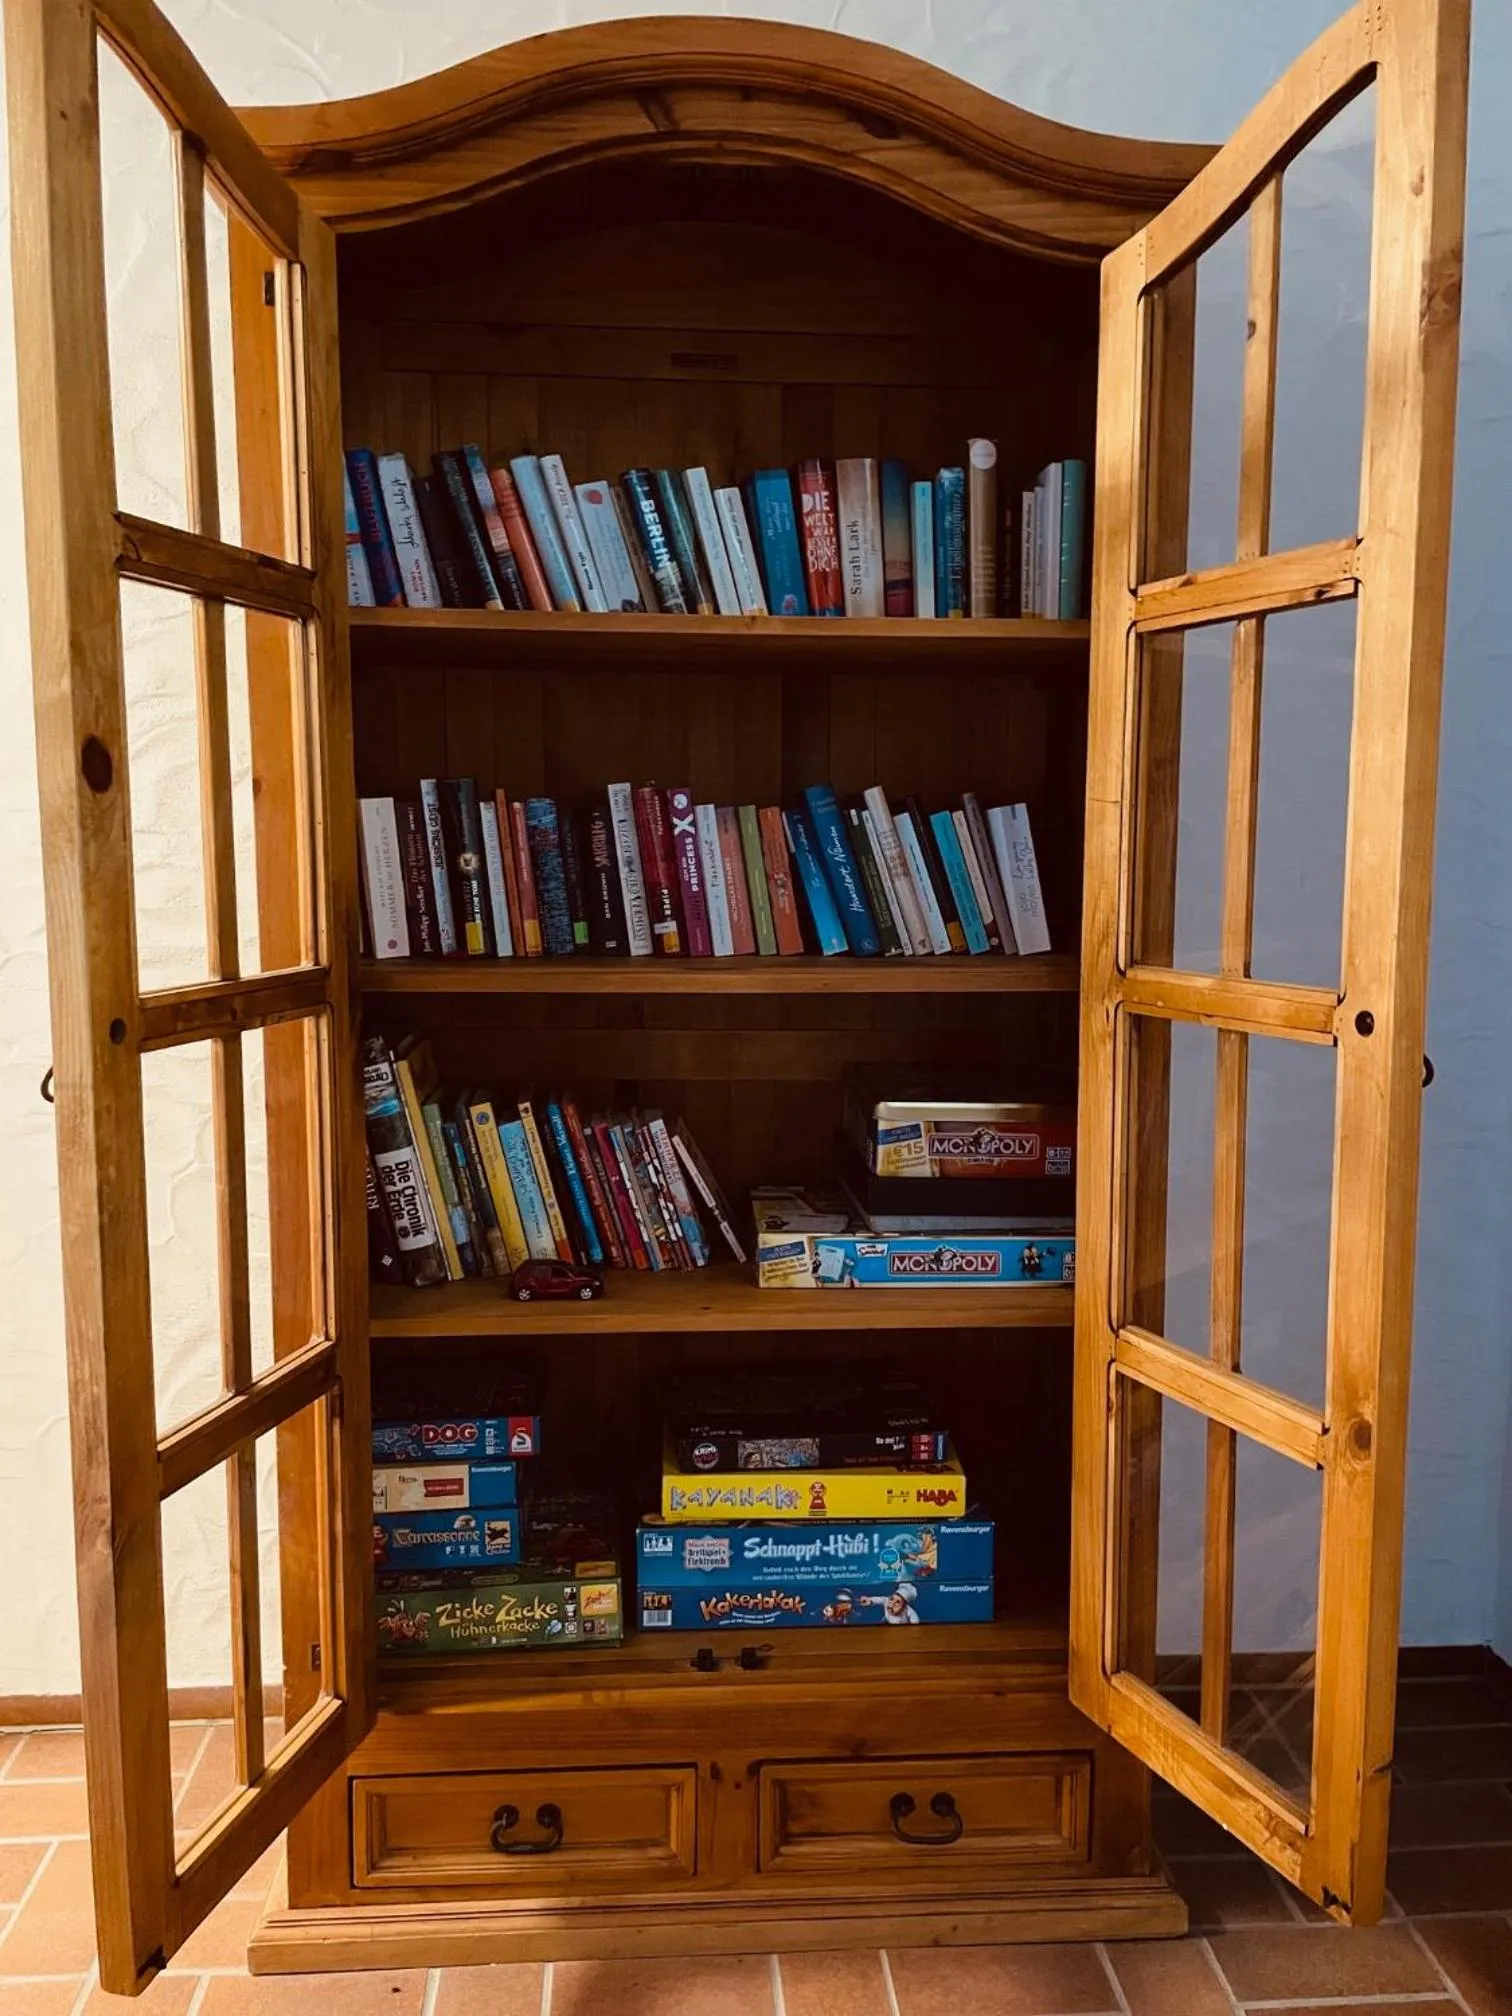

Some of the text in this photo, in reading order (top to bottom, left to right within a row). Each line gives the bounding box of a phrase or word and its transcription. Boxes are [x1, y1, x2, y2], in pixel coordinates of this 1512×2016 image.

[802, 491, 831, 511] DIE
[803, 512, 835, 527] WELT
[641, 499, 671, 568] BERLIN
[808, 557, 839, 572] DICH
[846, 520, 862, 595] Sarah Lark
[592, 820, 610, 868] SAKRILEG
[672, 813, 700, 892] PRINCESS X
[830, 825, 867, 913] Hundert Namen
[661, 889, 672, 915] PIPER
[932, 1140, 1033, 1154] MONOPOLY
[382, 1165, 406, 1222] der Erde
[394, 1161, 426, 1238] Die Chronik
[893, 1256, 996, 1271] MONOPOLY
[422, 1423, 479, 1444] DOG
[670, 1483, 798, 1511] KAYANAK
[916, 1489, 957, 1507] HABA
[393, 1528, 481, 1548] Carcassonne
[940, 1525, 991, 1535] Ravensburger
[939, 1584, 991, 1593] Ravensburger
[435, 1592, 559, 1628] Zicke Zacke
[699, 1588, 807, 1623] Kakerlakak
[451, 1619, 541, 1639] Hühnerkacke
